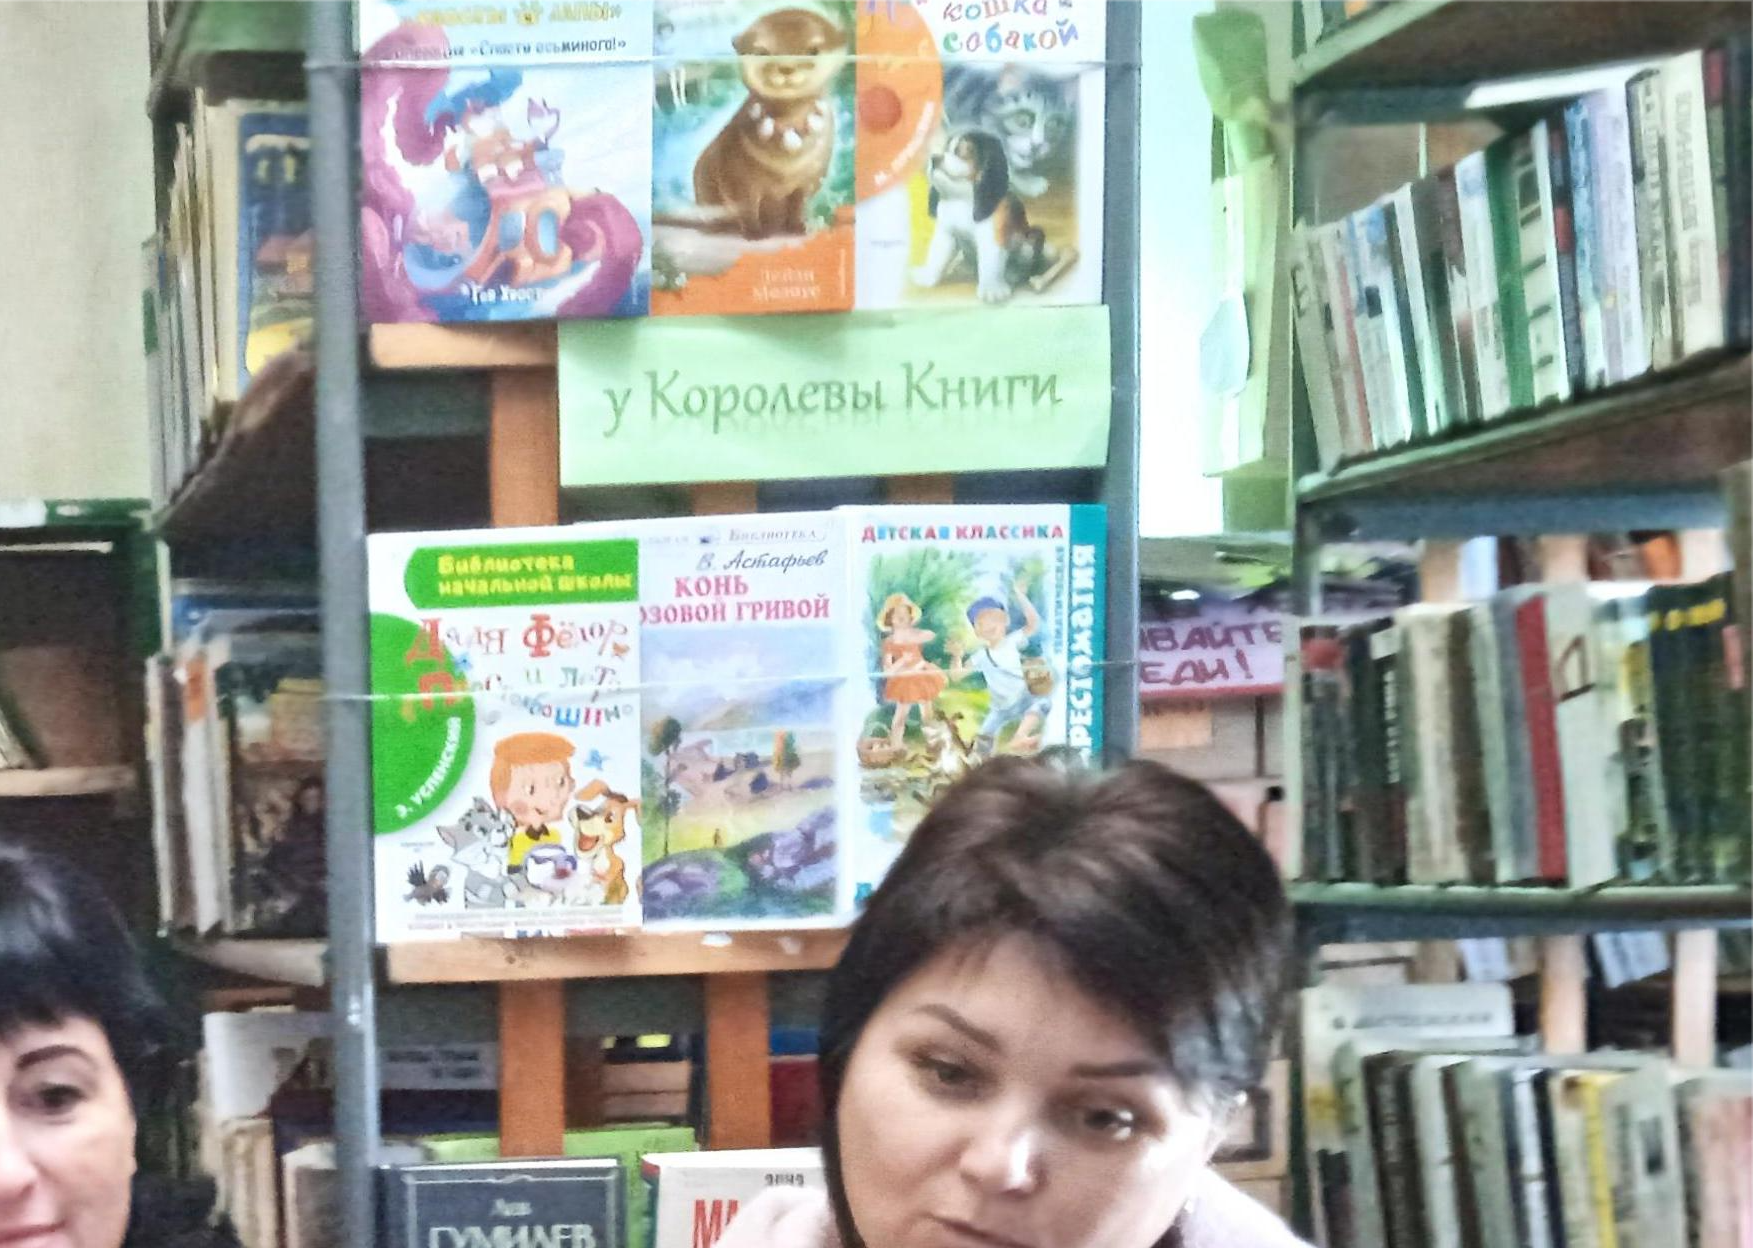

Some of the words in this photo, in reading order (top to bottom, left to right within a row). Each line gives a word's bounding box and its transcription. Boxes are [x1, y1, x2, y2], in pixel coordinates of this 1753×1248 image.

[943, 18, 1079, 53] собакой
[603, 388, 632, 438] у
[645, 369, 887, 435] Королевы
[901, 360, 1064, 411] Книги
[955, 525, 1064, 540] КЛАССИКА
[437, 554, 575, 575] Библиотека
[723, 549, 830, 574] Астафьев
[438, 574, 554, 597] начальной
[558, 572, 633, 593] школы
[674, 575, 750, 598] КОНЬ
[736, 593, 831, 623] ГРИВОЙ
